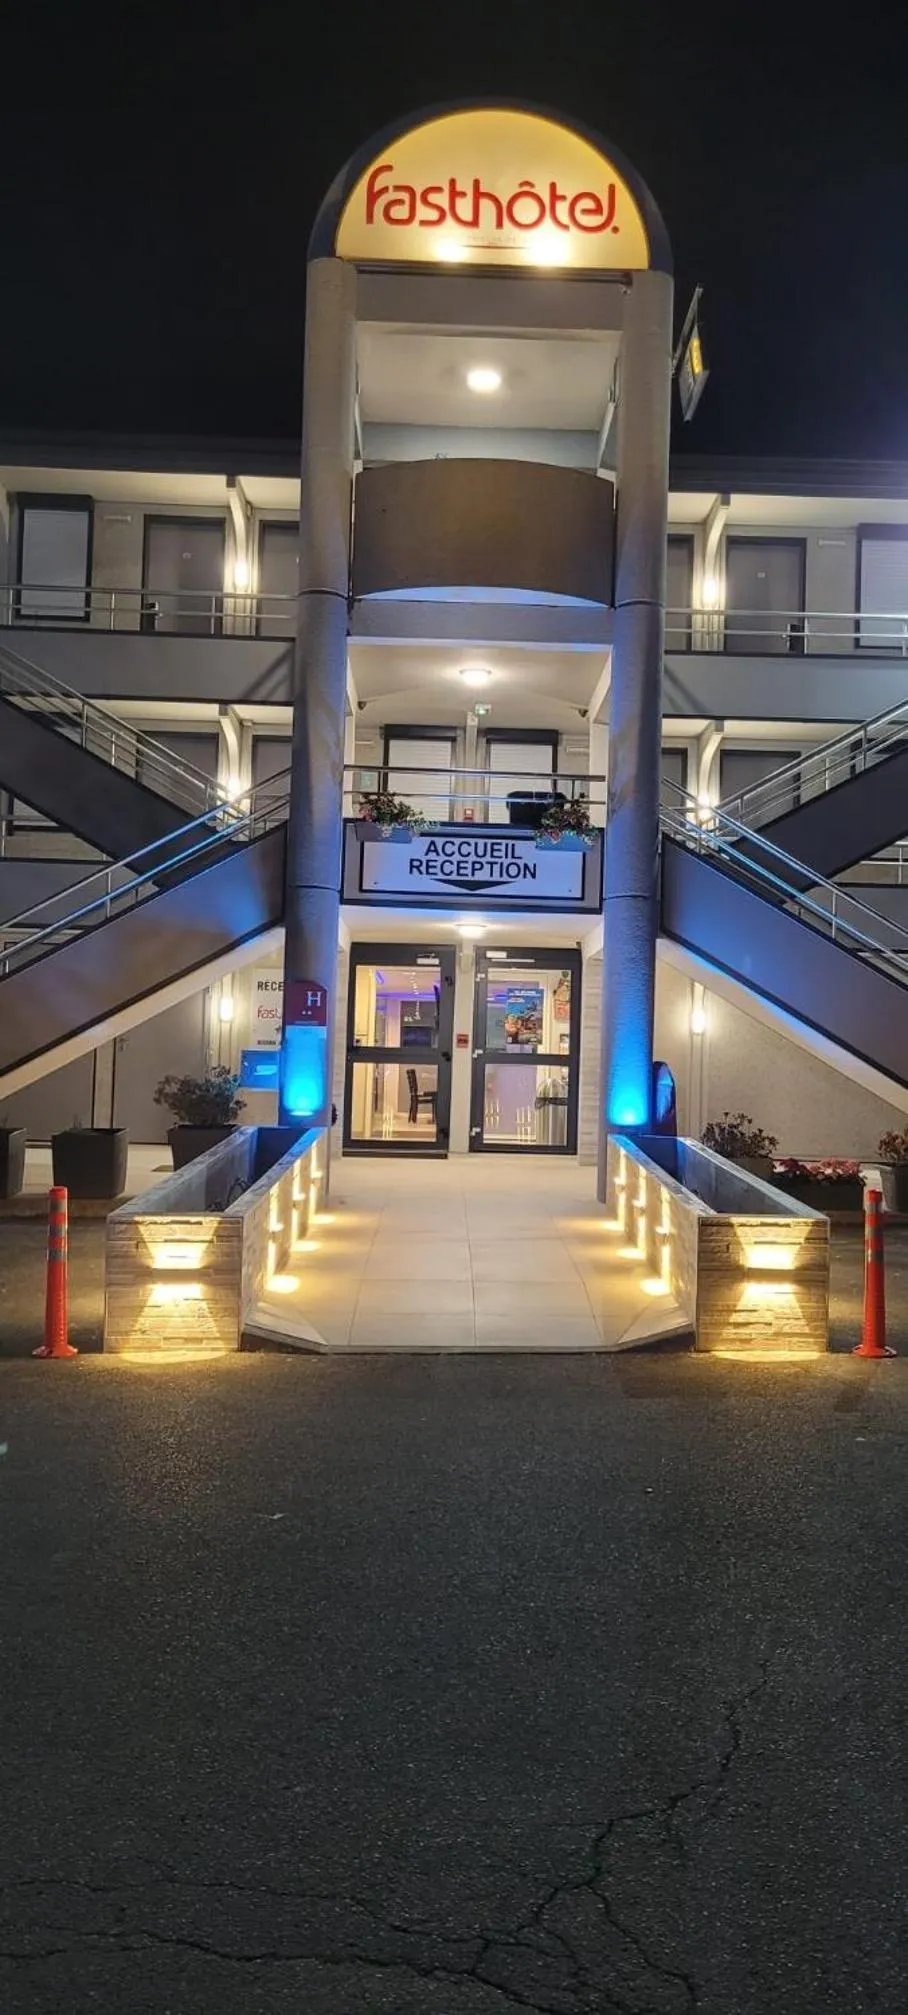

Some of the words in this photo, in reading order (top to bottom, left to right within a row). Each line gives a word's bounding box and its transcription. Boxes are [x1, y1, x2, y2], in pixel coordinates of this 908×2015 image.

[424, 840, 523, 860] ACCUEIL
[409, 858, 537, 879] RECEPTION
[307, 991, 321, 1007] H
